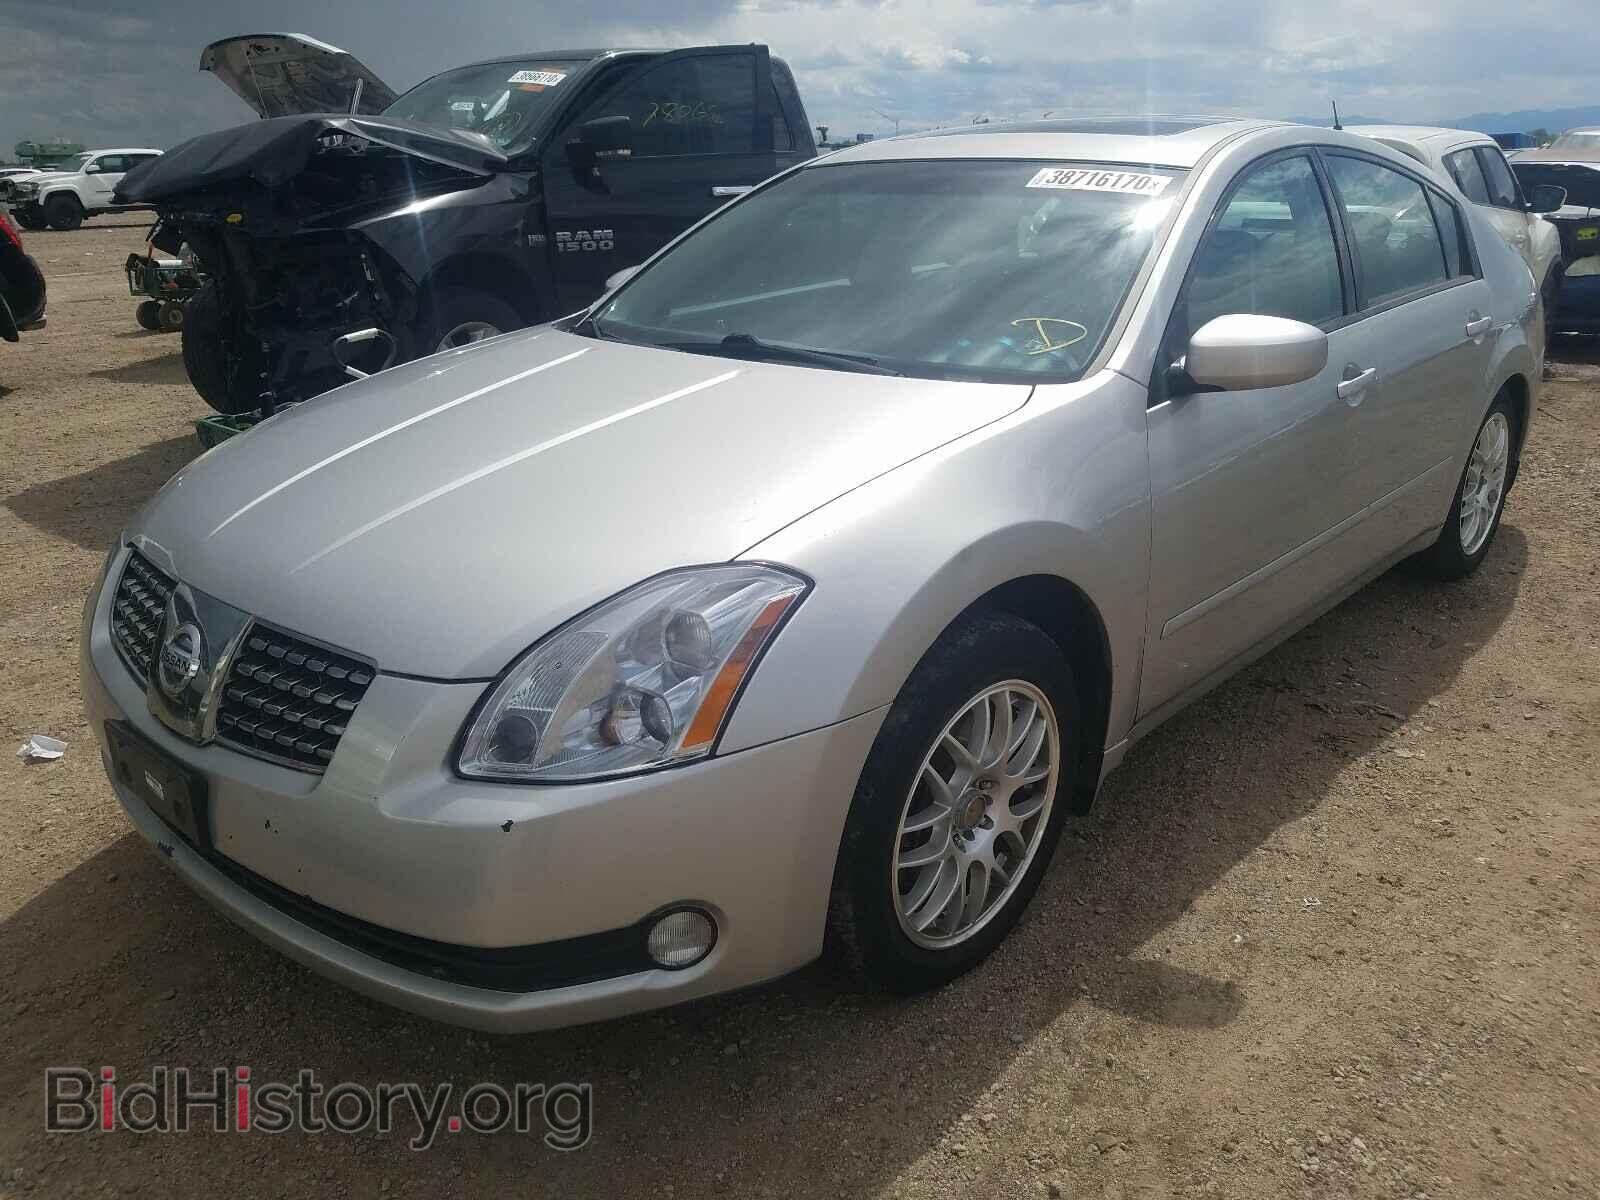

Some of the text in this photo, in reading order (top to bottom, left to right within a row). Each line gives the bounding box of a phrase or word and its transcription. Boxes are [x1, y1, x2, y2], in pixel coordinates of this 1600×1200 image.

[1046, 170, 1152, 190] 38716170
[556, 229, 614, 241] RAM
[557, 240, 614, 252] 1500
